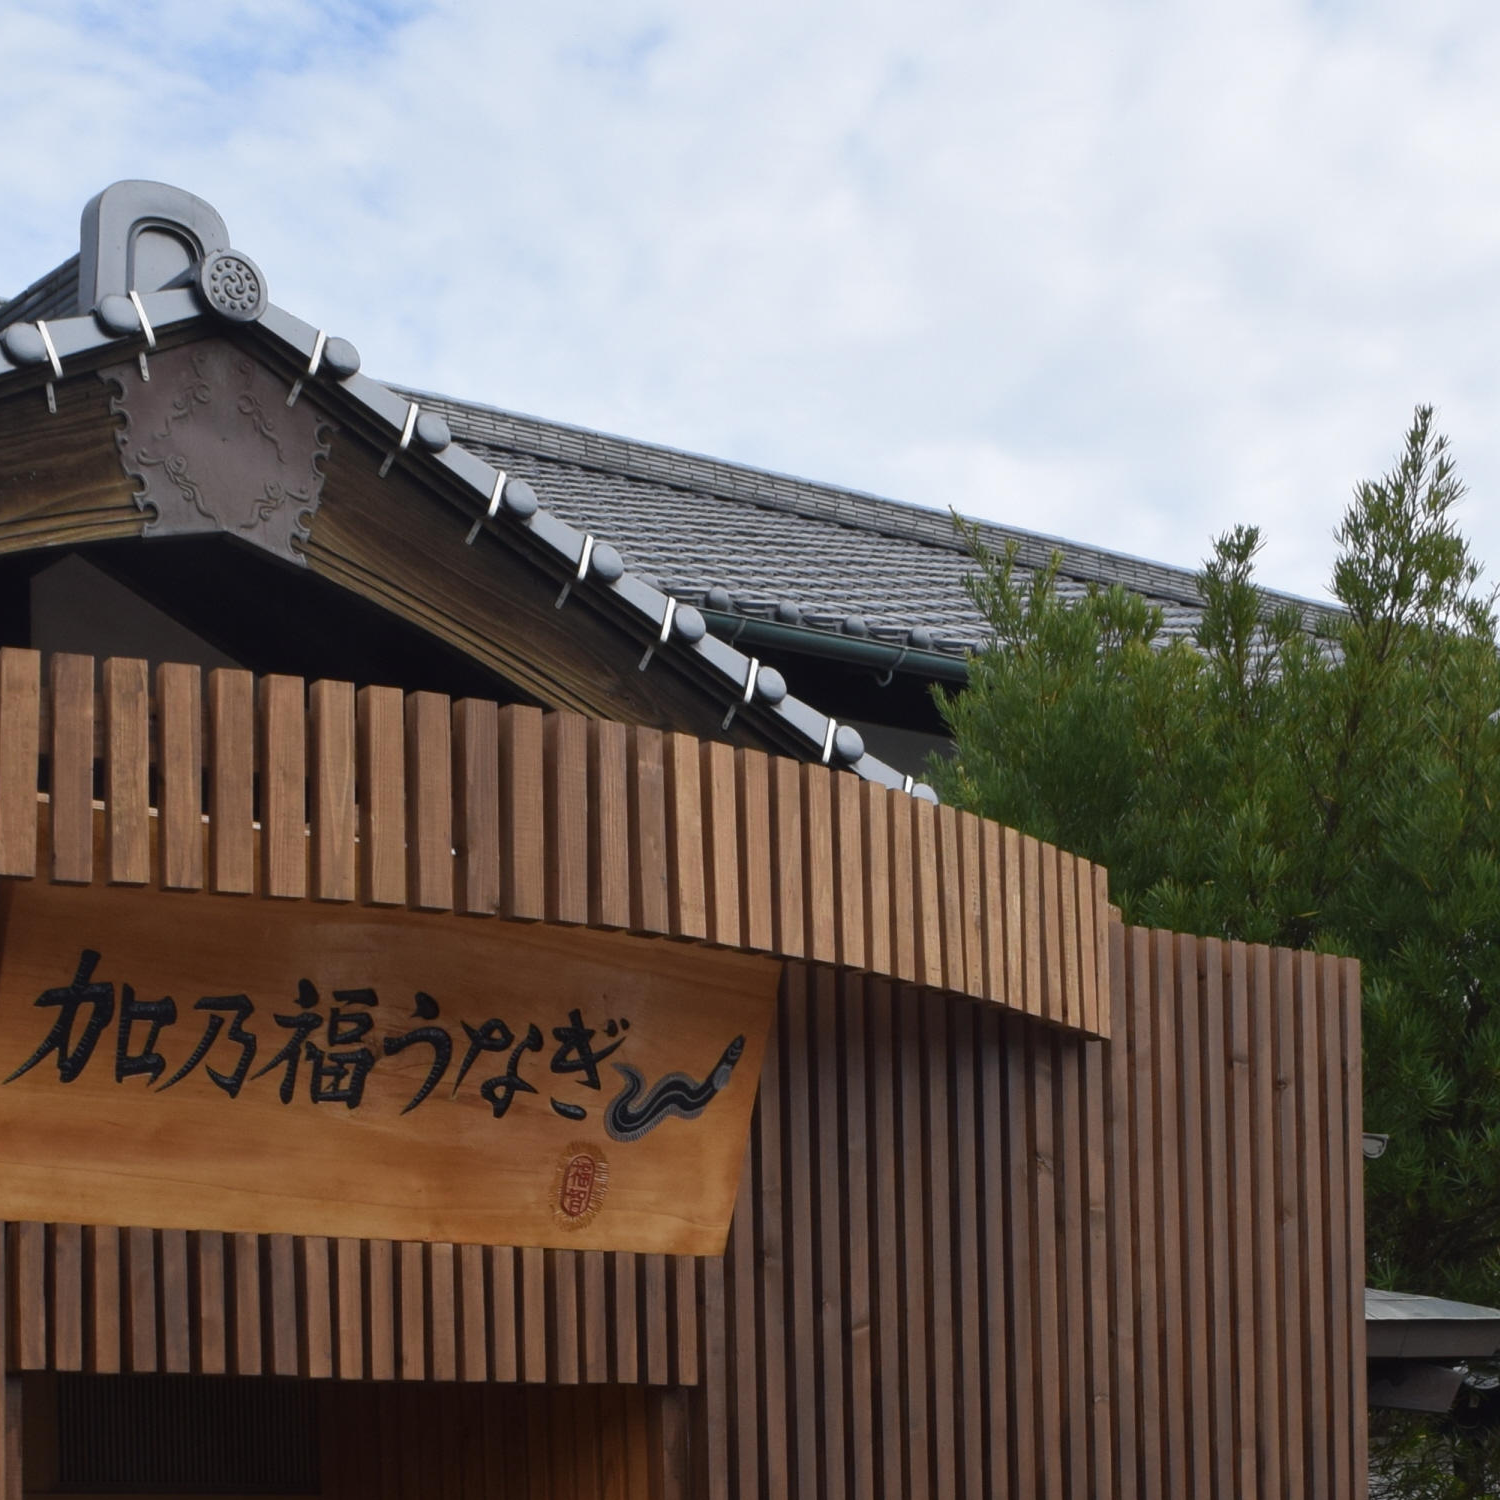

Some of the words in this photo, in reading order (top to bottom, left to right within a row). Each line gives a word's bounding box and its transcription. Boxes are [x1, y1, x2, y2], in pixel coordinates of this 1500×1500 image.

[2, 948, 629, 1120] 加乃福うなぎ
